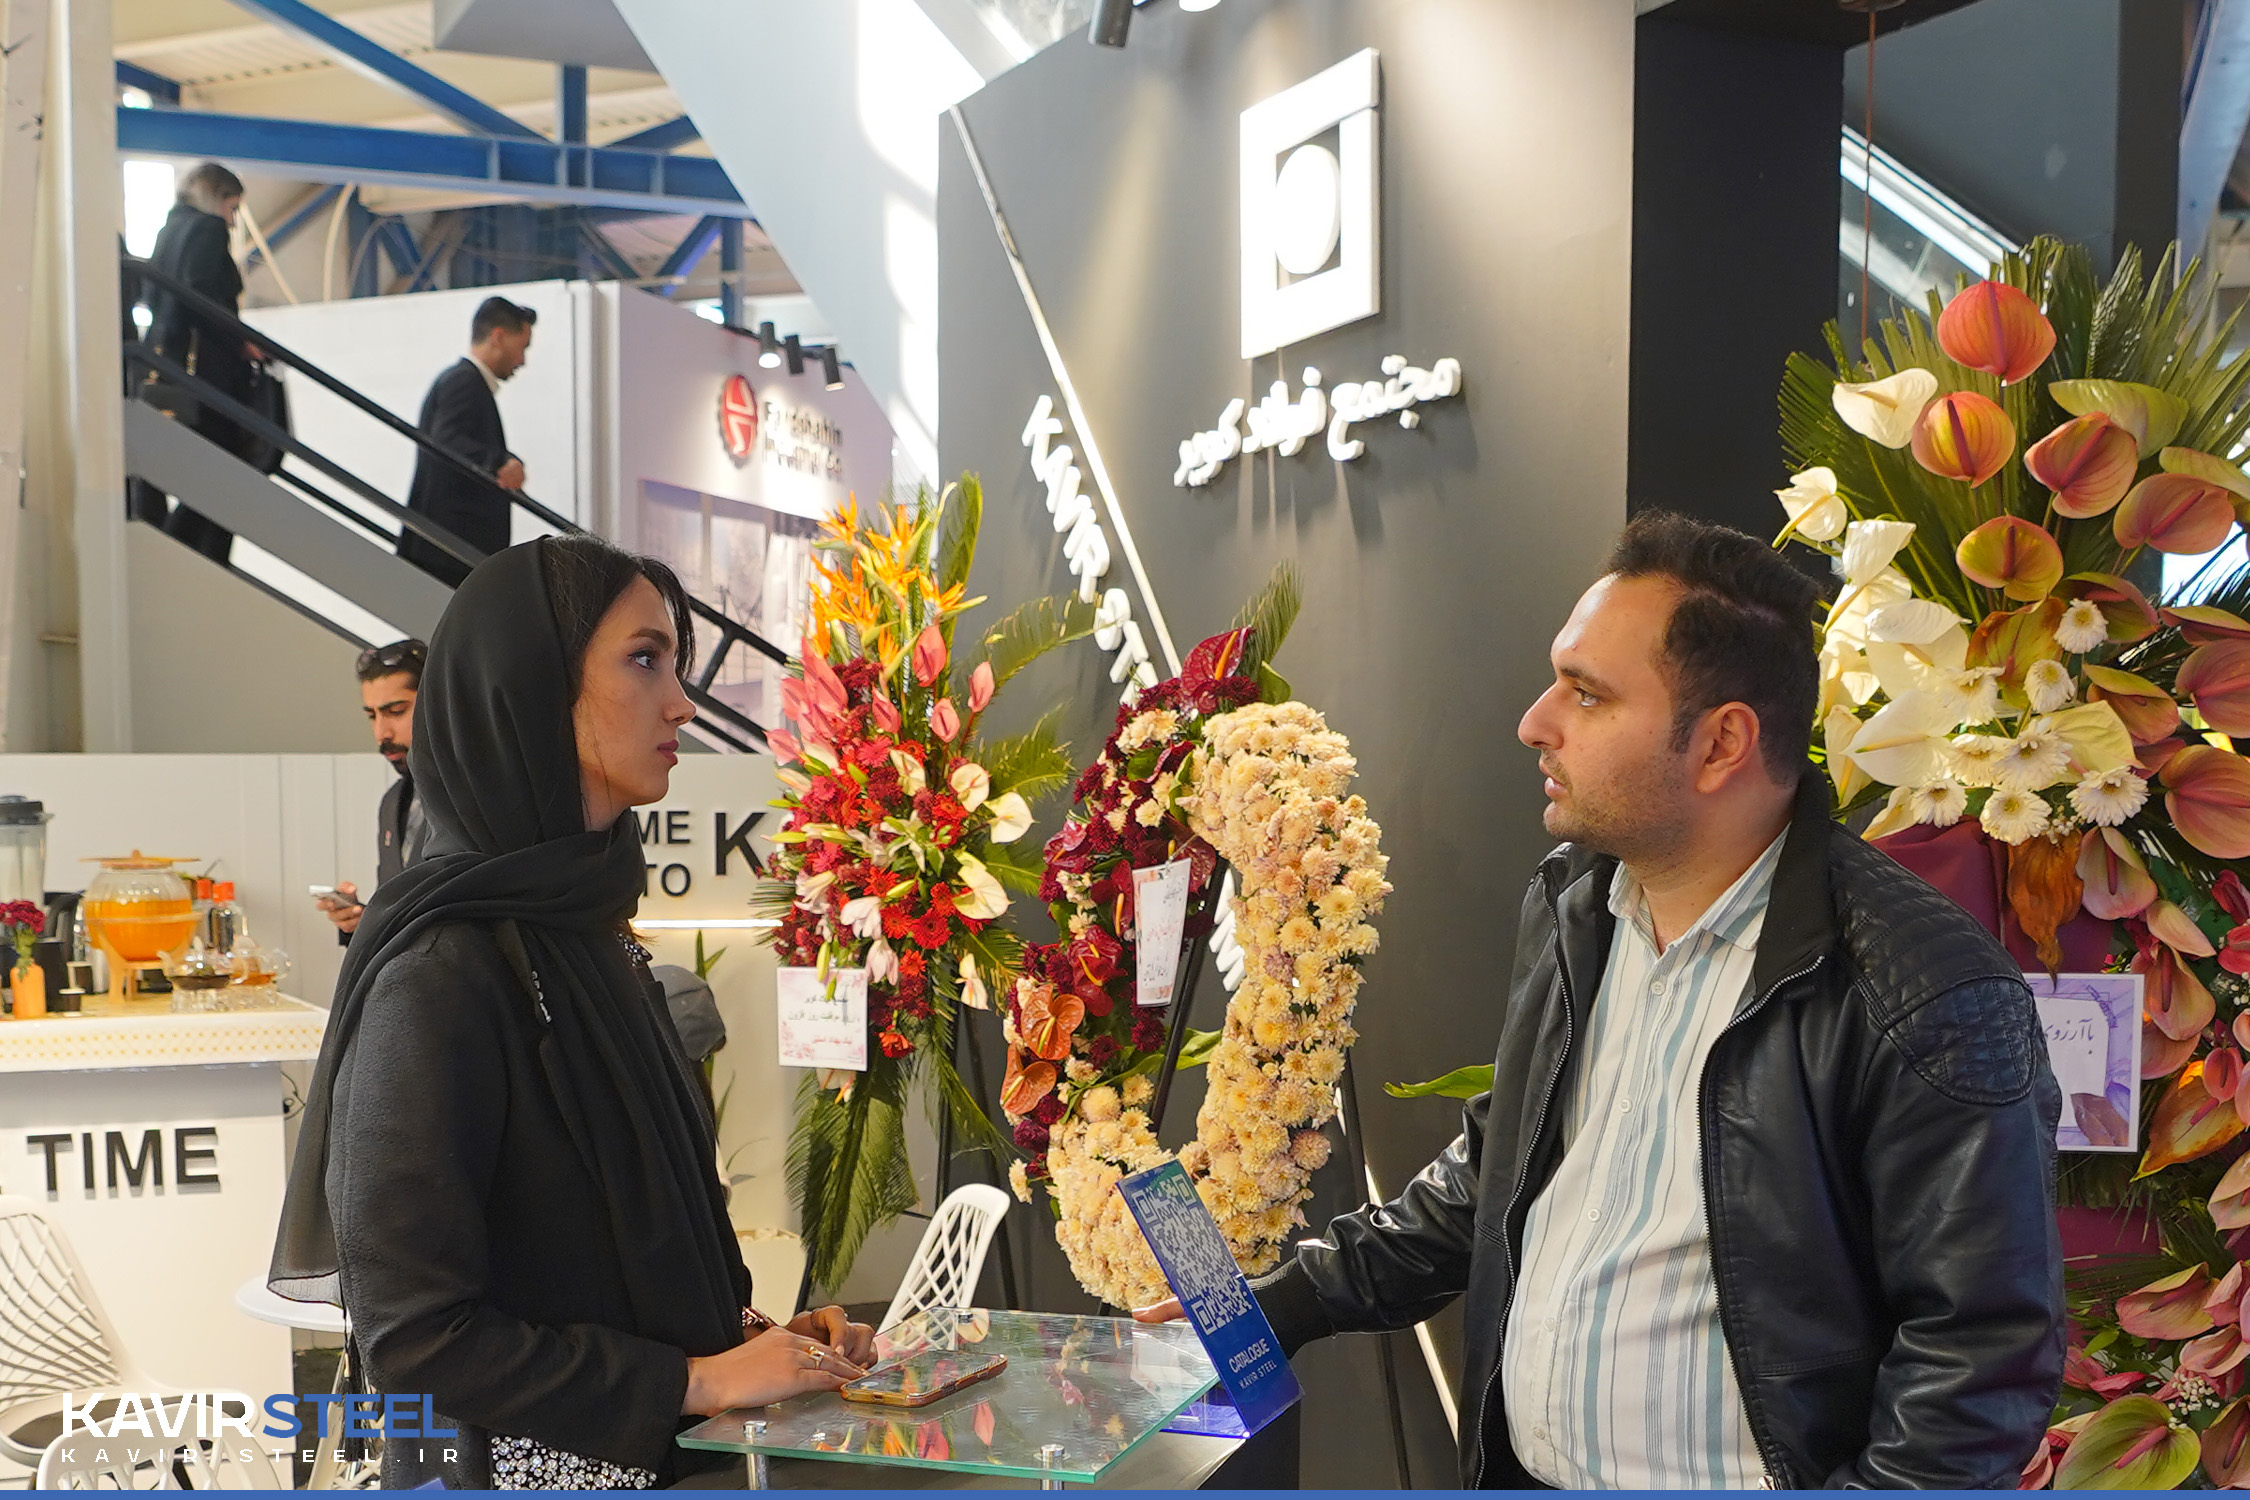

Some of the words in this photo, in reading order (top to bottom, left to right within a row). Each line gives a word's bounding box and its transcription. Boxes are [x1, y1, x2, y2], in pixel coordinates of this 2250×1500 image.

[1327, 354, 1462, 462] مجتمع
[632, 810, 691, 845] ME
[26, 1127, 220, 1194] TIME
[1228, 1338, 1270, 1374] CATALOGUE
[1257, 1359, 1278, 1378] STEEL
